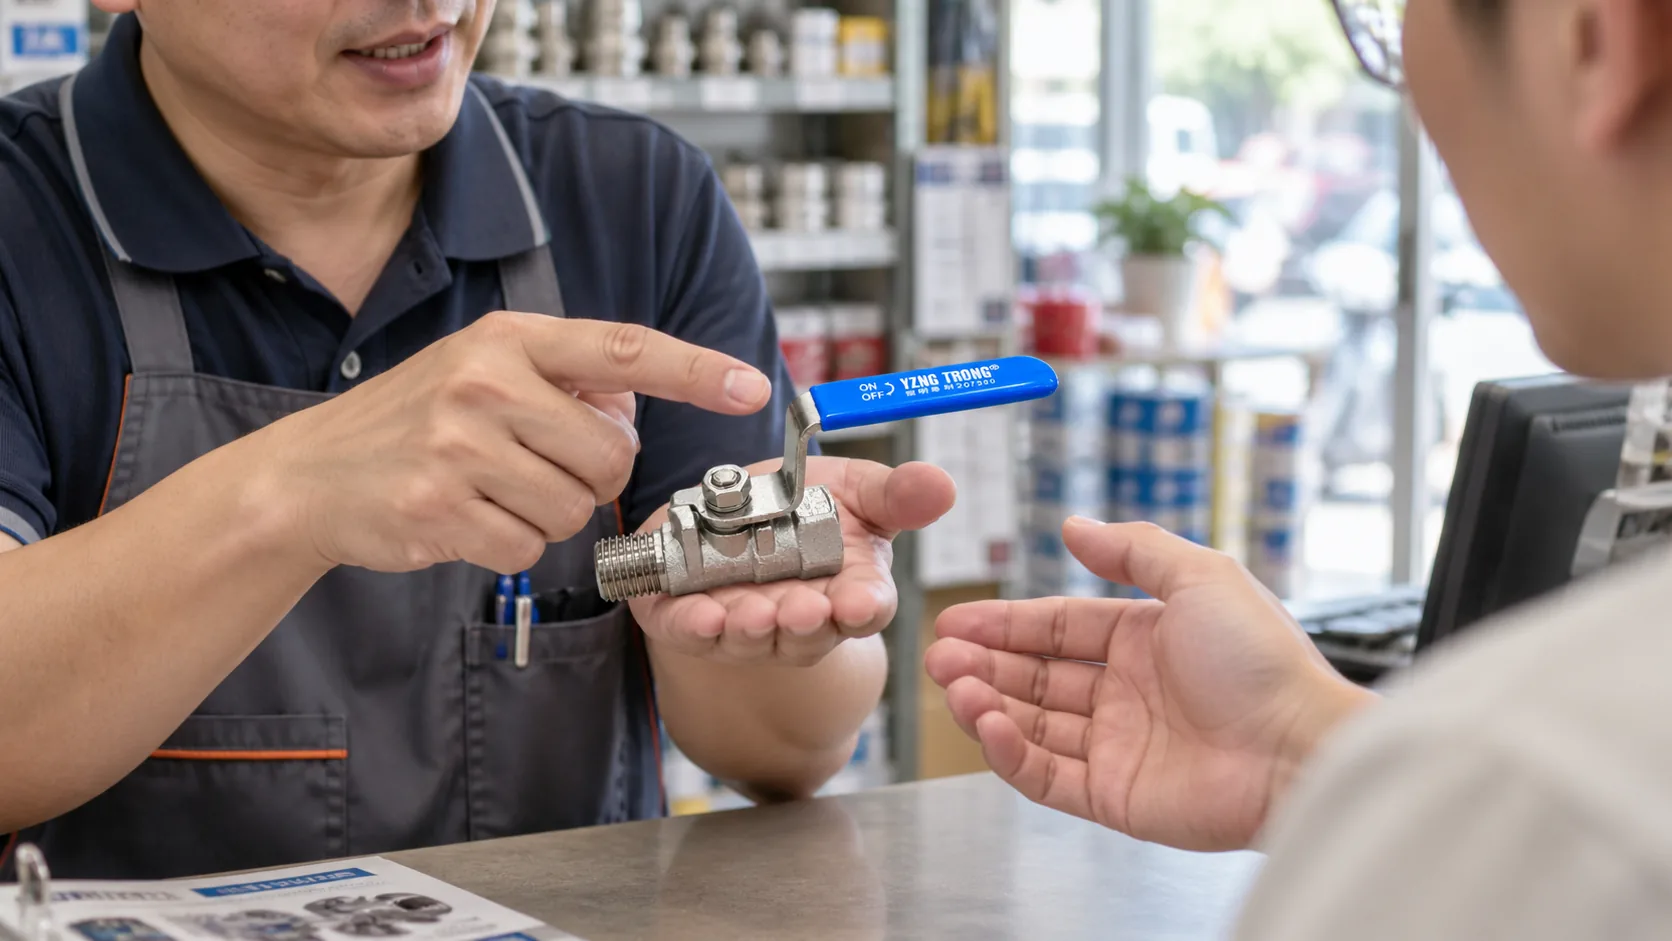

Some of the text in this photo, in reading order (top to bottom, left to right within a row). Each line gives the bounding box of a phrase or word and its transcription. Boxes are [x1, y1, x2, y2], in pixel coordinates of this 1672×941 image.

[900, 373, 939, 389] YZNG
[859, 382, 877, 391] ON
[862, 391, 885, 401] OFF
